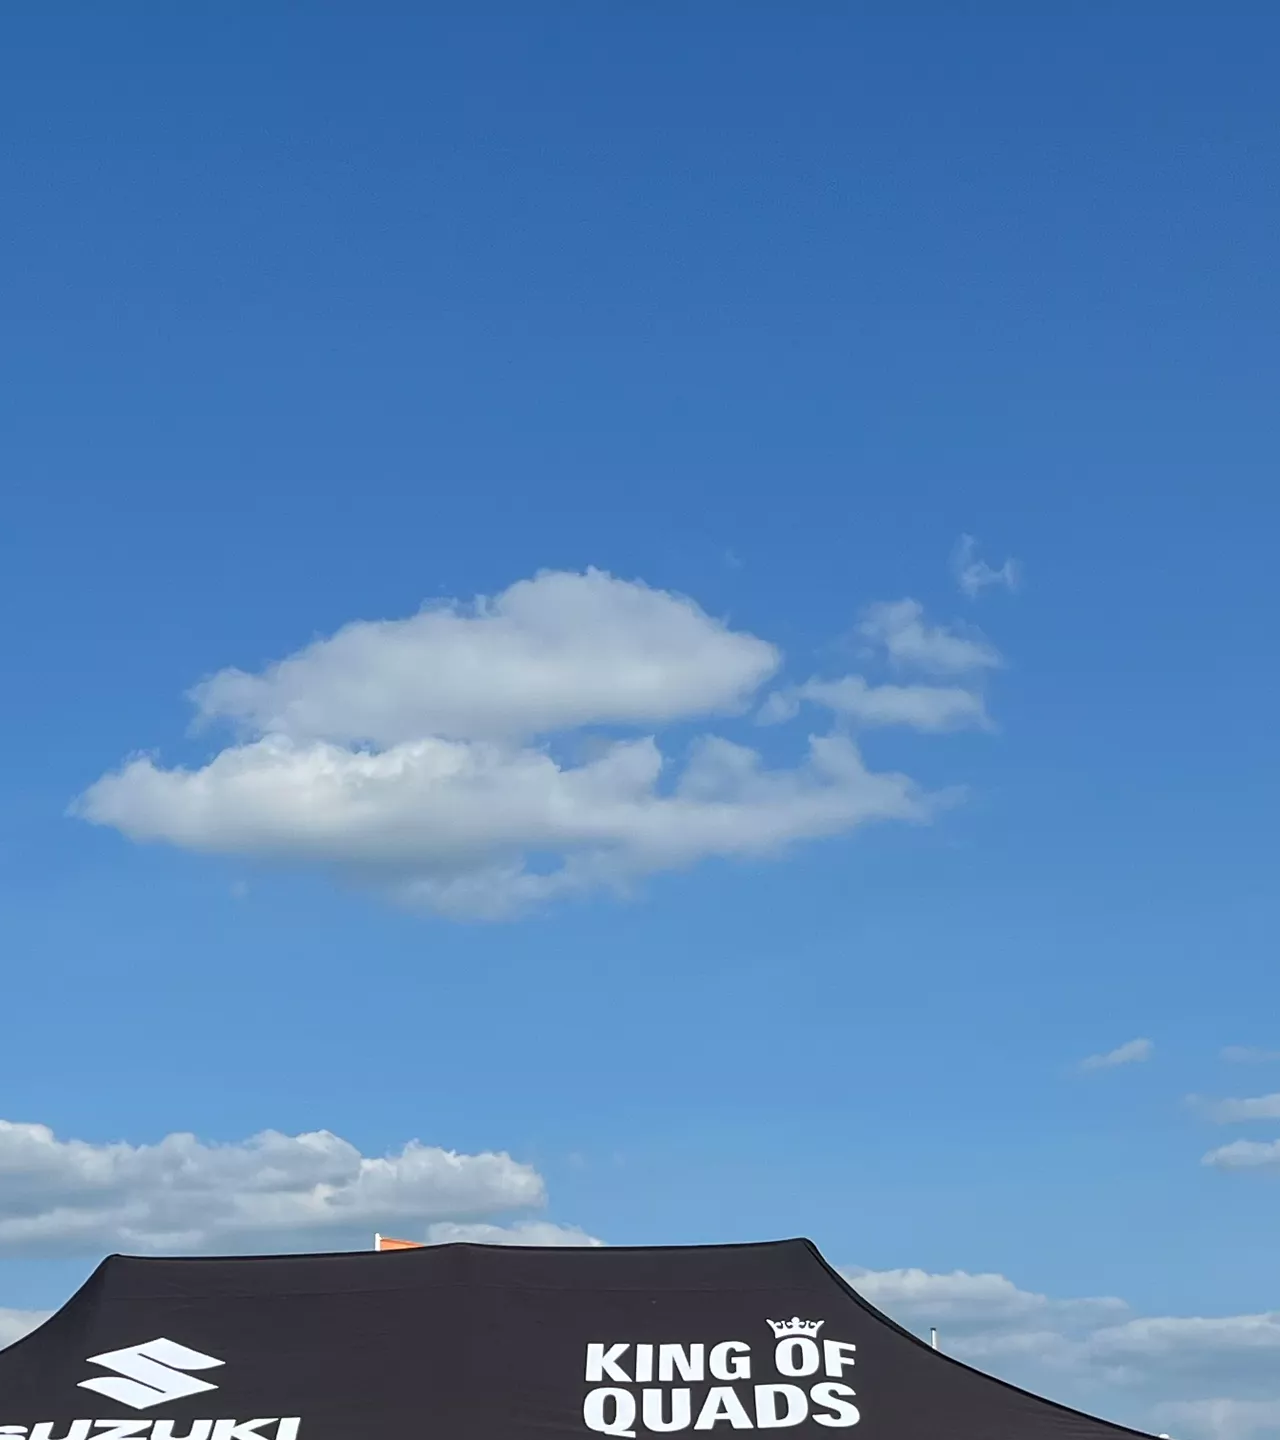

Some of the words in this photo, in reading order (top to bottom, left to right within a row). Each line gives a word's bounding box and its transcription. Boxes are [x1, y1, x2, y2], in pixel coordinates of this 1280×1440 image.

[582, 1342, 750, 1384] KING
[774, 1337, 857, 1379] OF
[581, 1383, 861, 1439] QUADS
